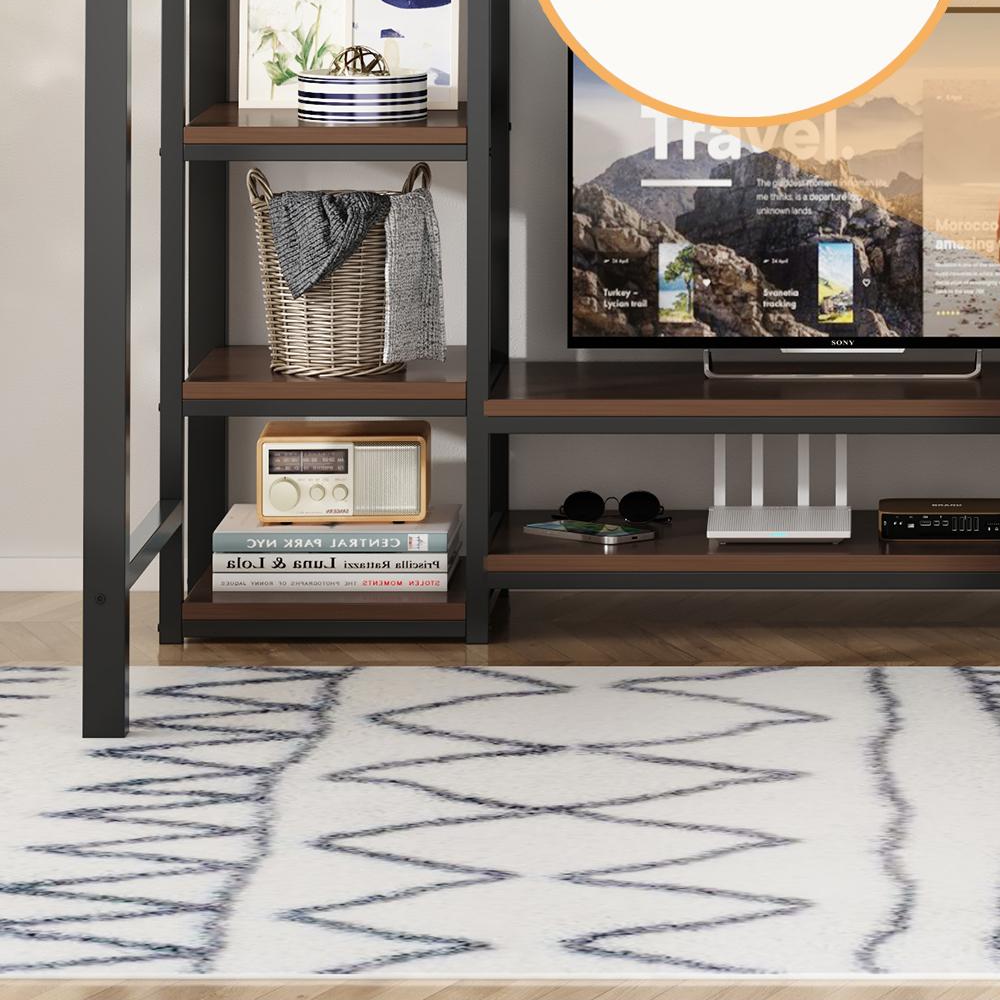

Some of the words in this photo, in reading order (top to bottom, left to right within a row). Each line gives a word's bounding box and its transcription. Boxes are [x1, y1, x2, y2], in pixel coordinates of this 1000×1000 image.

[756, 178, 770, 187] The
[809, 193, 847, 203] departure
[756, 206, 791, 215] unknown
[935, 218, 1000, 231] Morocco
[935, 236, 994, 252] amazing
[603, 288, 631, 299] Turkey
[763, 288, 799, 297] Svanetia
[603, 299, 630, 310] Lycian
[631, 299, 648, 308] trail
[763, 299, 797, 310] tracking
